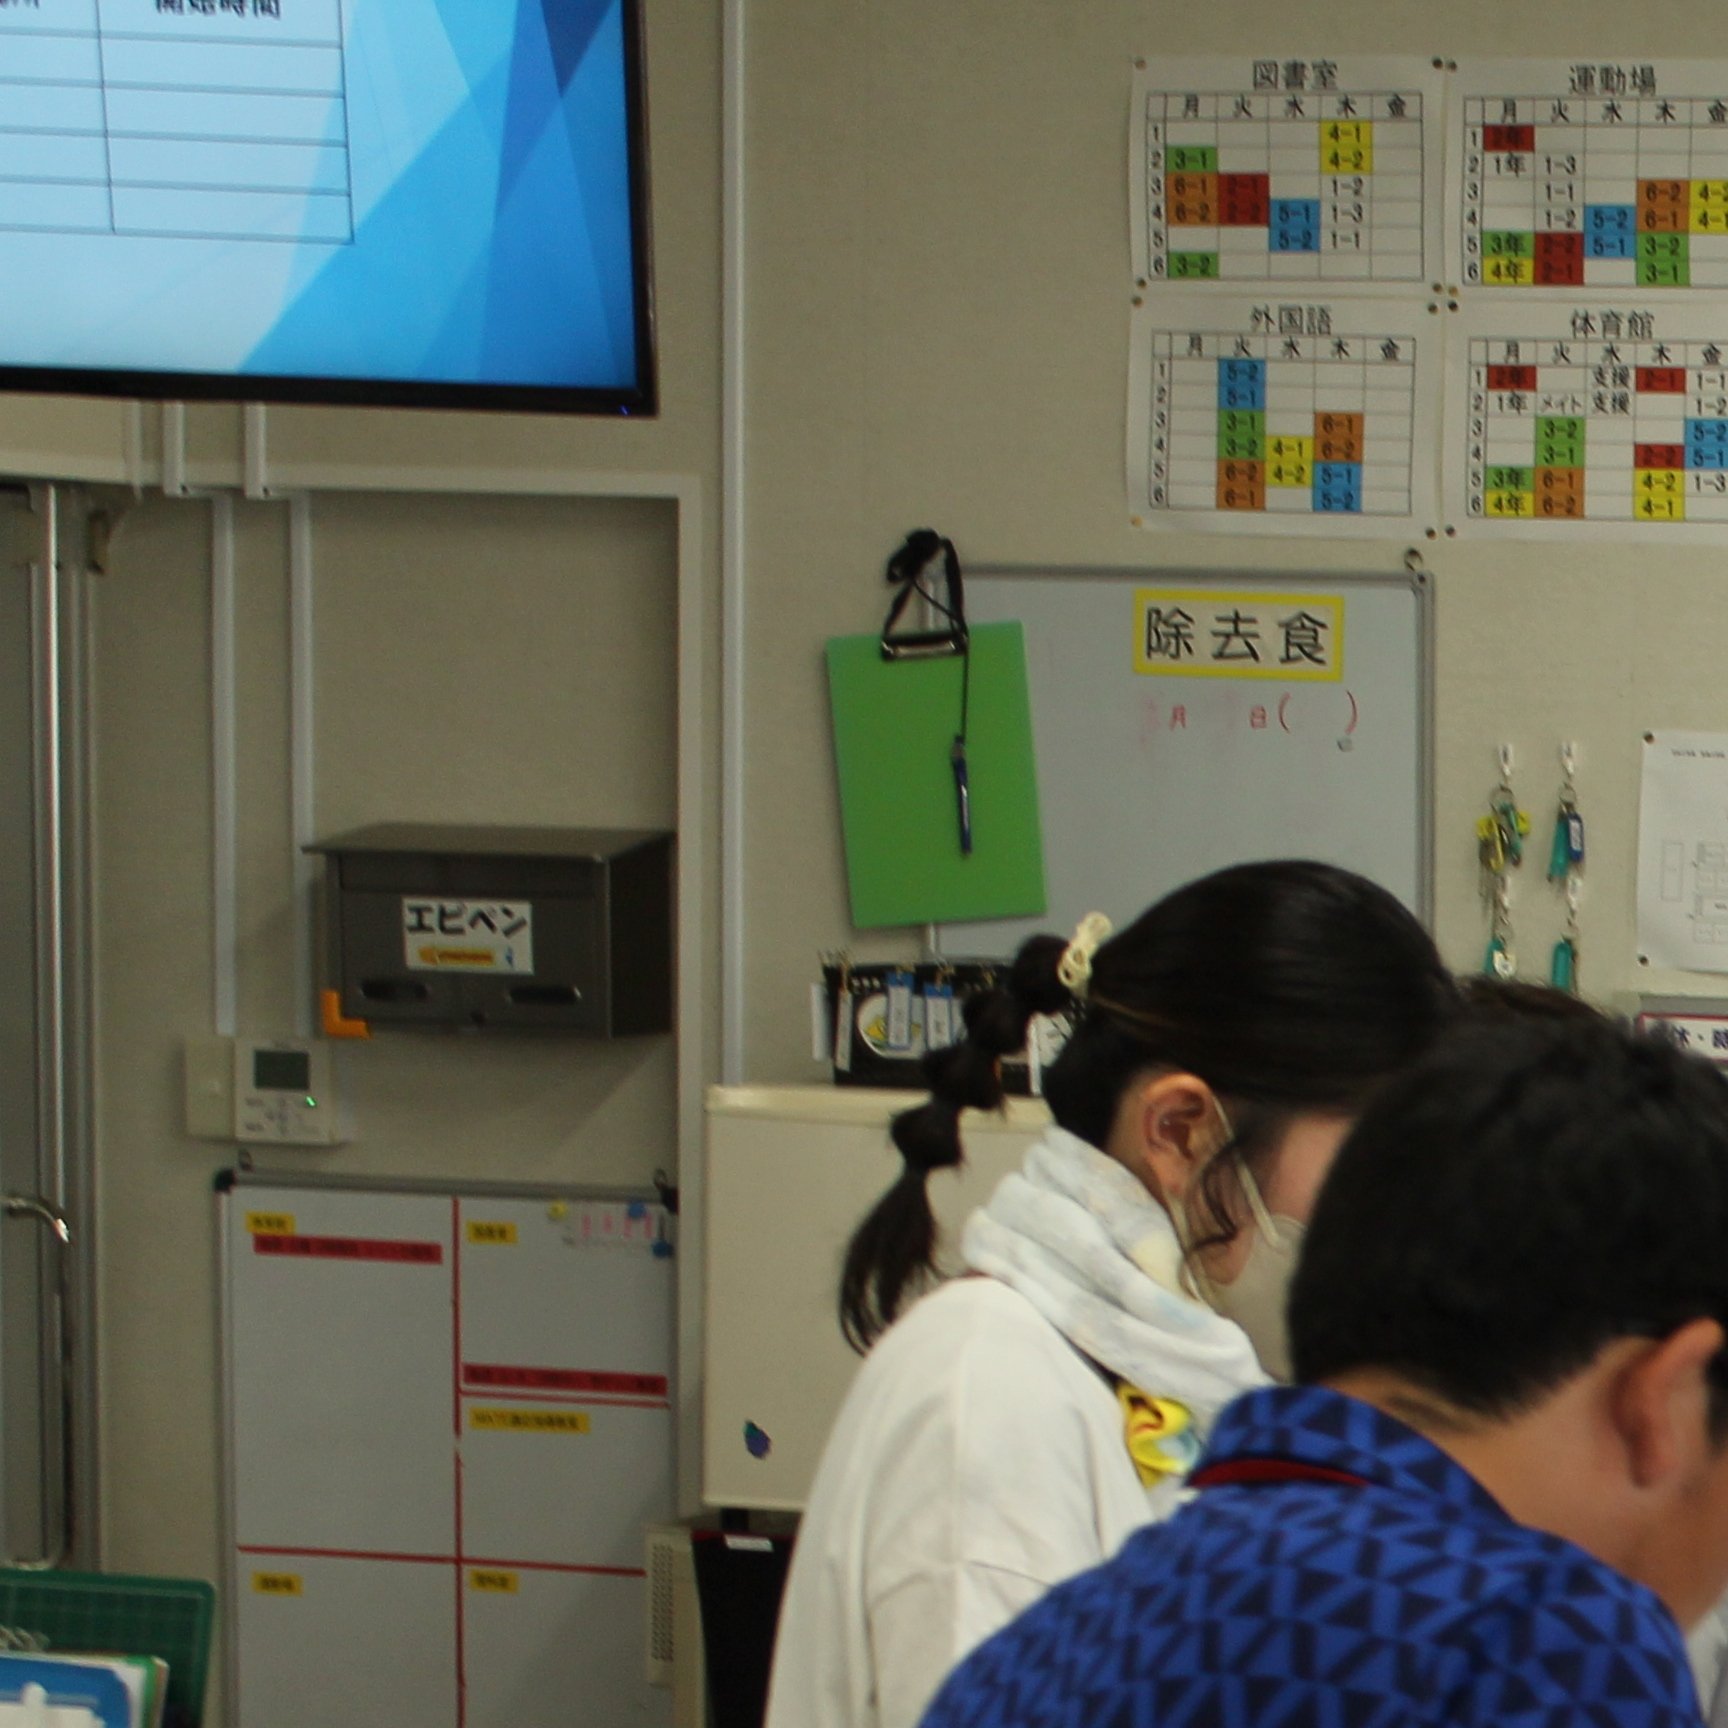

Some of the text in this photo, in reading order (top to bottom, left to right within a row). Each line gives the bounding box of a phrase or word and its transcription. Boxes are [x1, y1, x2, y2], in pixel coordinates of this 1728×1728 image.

[1495, 155, 1525, 177] 1年
[1546, 155, 1577, 175] 1-3
[1546, 183, 1574, 201] 1-1
[1646, 182, 1681, 202] 6-2
[1546, 208, 1577, 229] 1-2
[1593, 209, 1628, 229] 5-2
[1645, 236, 1680, 256] 3-2
[1492, 260, 1523, 283] 4年
[1144, 605, 1330, 666] 除去食
[406, 902, 528, 939] エピペン
